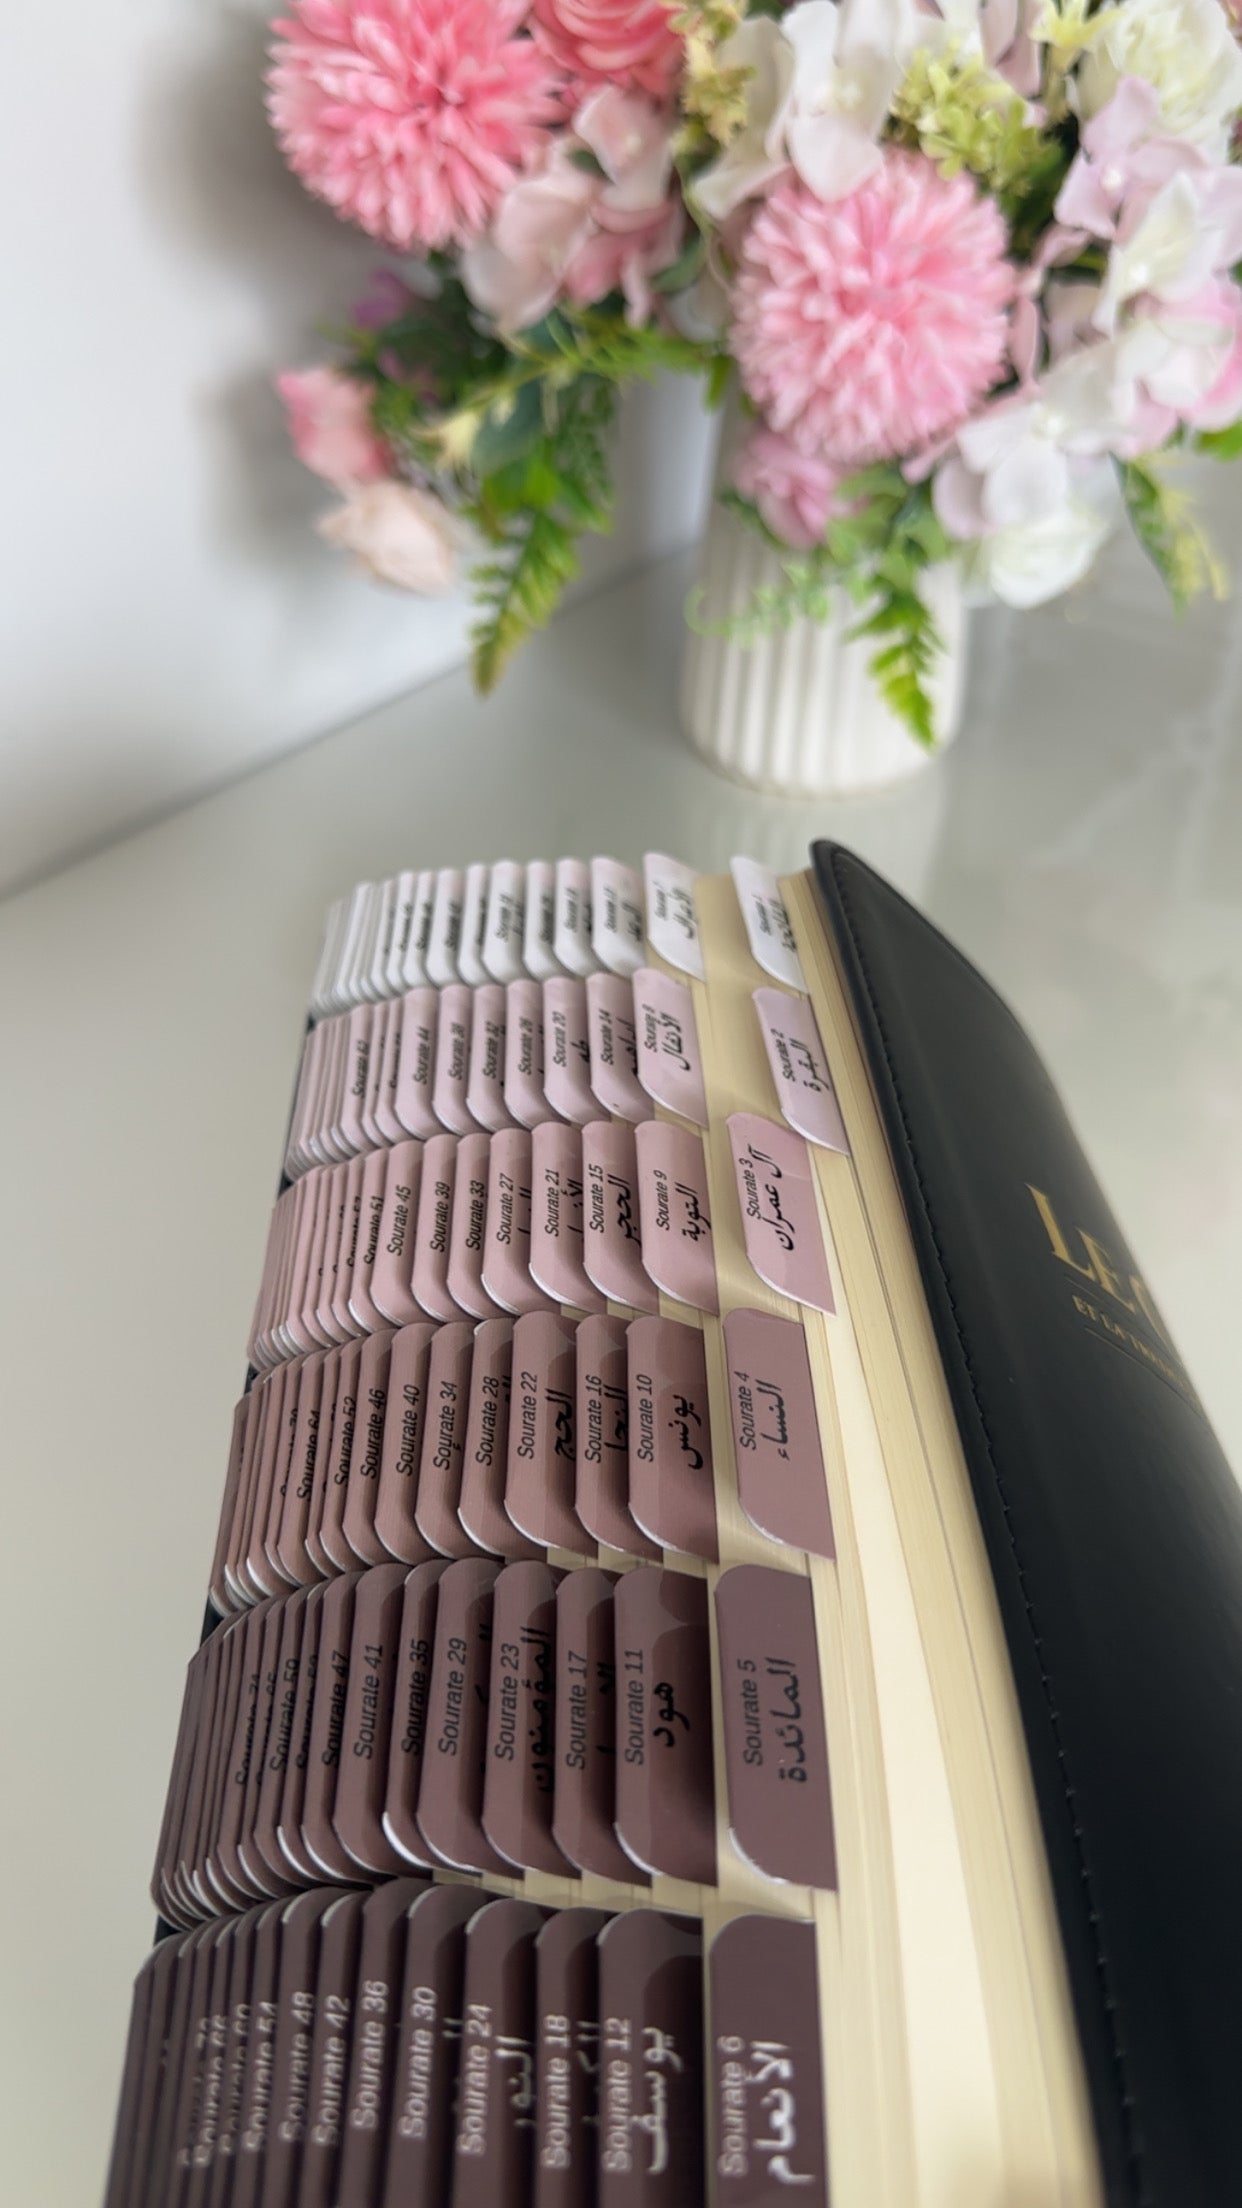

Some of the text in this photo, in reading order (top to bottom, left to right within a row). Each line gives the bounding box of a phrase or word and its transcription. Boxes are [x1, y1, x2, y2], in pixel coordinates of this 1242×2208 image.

[412, 1042, 430, 1085] Sourate
[448, 1038, 464, 1080] Sourate
[483, 1038, 498, 1079] Sourate
[518, 1034, 532, 1076] Sourate
[554, 1029, 567, 1067] Sourate
[599, 1008, 615, 1065] Sourate 14
[771, 1028, 796, 1082] Sourate 2
[387, 1185, 411, 1256] Sourate 45
[430, 1181, 451, 1253] Sourate 39
[466, 1180, 485, 1251] Sourate 33
[497, 1173, 514, 1245] Sourate 27
[544, 1168, 560, 1237] Sourate 21
[589, 1163, 605, 1233] Sourate 15
[607, 1174, 642, 1248] الحجر
[653, 1169, 670, 1231] Sourate 9
[675, 1183, 712, 1241] التوبة
[739, 1158, 762, 1219] Sourate 3
[762, 1184, 795, 1251] عمران
[1024, 1182, 1137, 1315] LE
[334, 1395, 357, 1487] Sourate 52
[360, 1387, 386, 1480] Sourate 46
[396, 1384, 420, 1477] Sourate 40
[433, 1380, 458, 1471] Sourate 34
[475, 1376, 500, 1466] Sourate 28
[517, 1371, 538, 1460] Sourate 22
[585, 1374, 602, 1463] Sourate 16
[636, 1374, 654, 1462] Sourate 10
[668, 1394, 704, 1470] يونس
[735, 1371, 757, 1450] Sourate 4
[754, 1379, 791, 1461] النساء
[322, 1650, 349, 1767] Sourate 47
[353, 1644, 383, 1760] Sourate 41
[400, 1638, 429, 1756] Sourate 35
[438, 1637, 467, 1757] Sourate 29
[495, 1643, 520, 1762] Sourate 23
[566, 1650, 588, 1770] Sourate 17
[625, 1649, 645, 1766] Sourate 11
[653, 1682, 690, 1748] هود
[737, 1659, 763, 1766] Sourate 5
[765, 1657, 808, 1783] المائدة
[278, 2033, 310, 2142] Sourate
[311, 1995, 350, 2147] Sourate 42
[352, 1980, 389, 2129] Sourate 36
[398, 1986, 437, 2139] Sourate 30
[456, 2003, 492, 2155] Sourate 24
[541, 2014, 571, 2169] Sourate 18
[602, 2017, 632, 2174] Sourate 12
[631, 2026, 684, 2176] يوسف
[716, 2035, 749, 2178] Sourate 6
